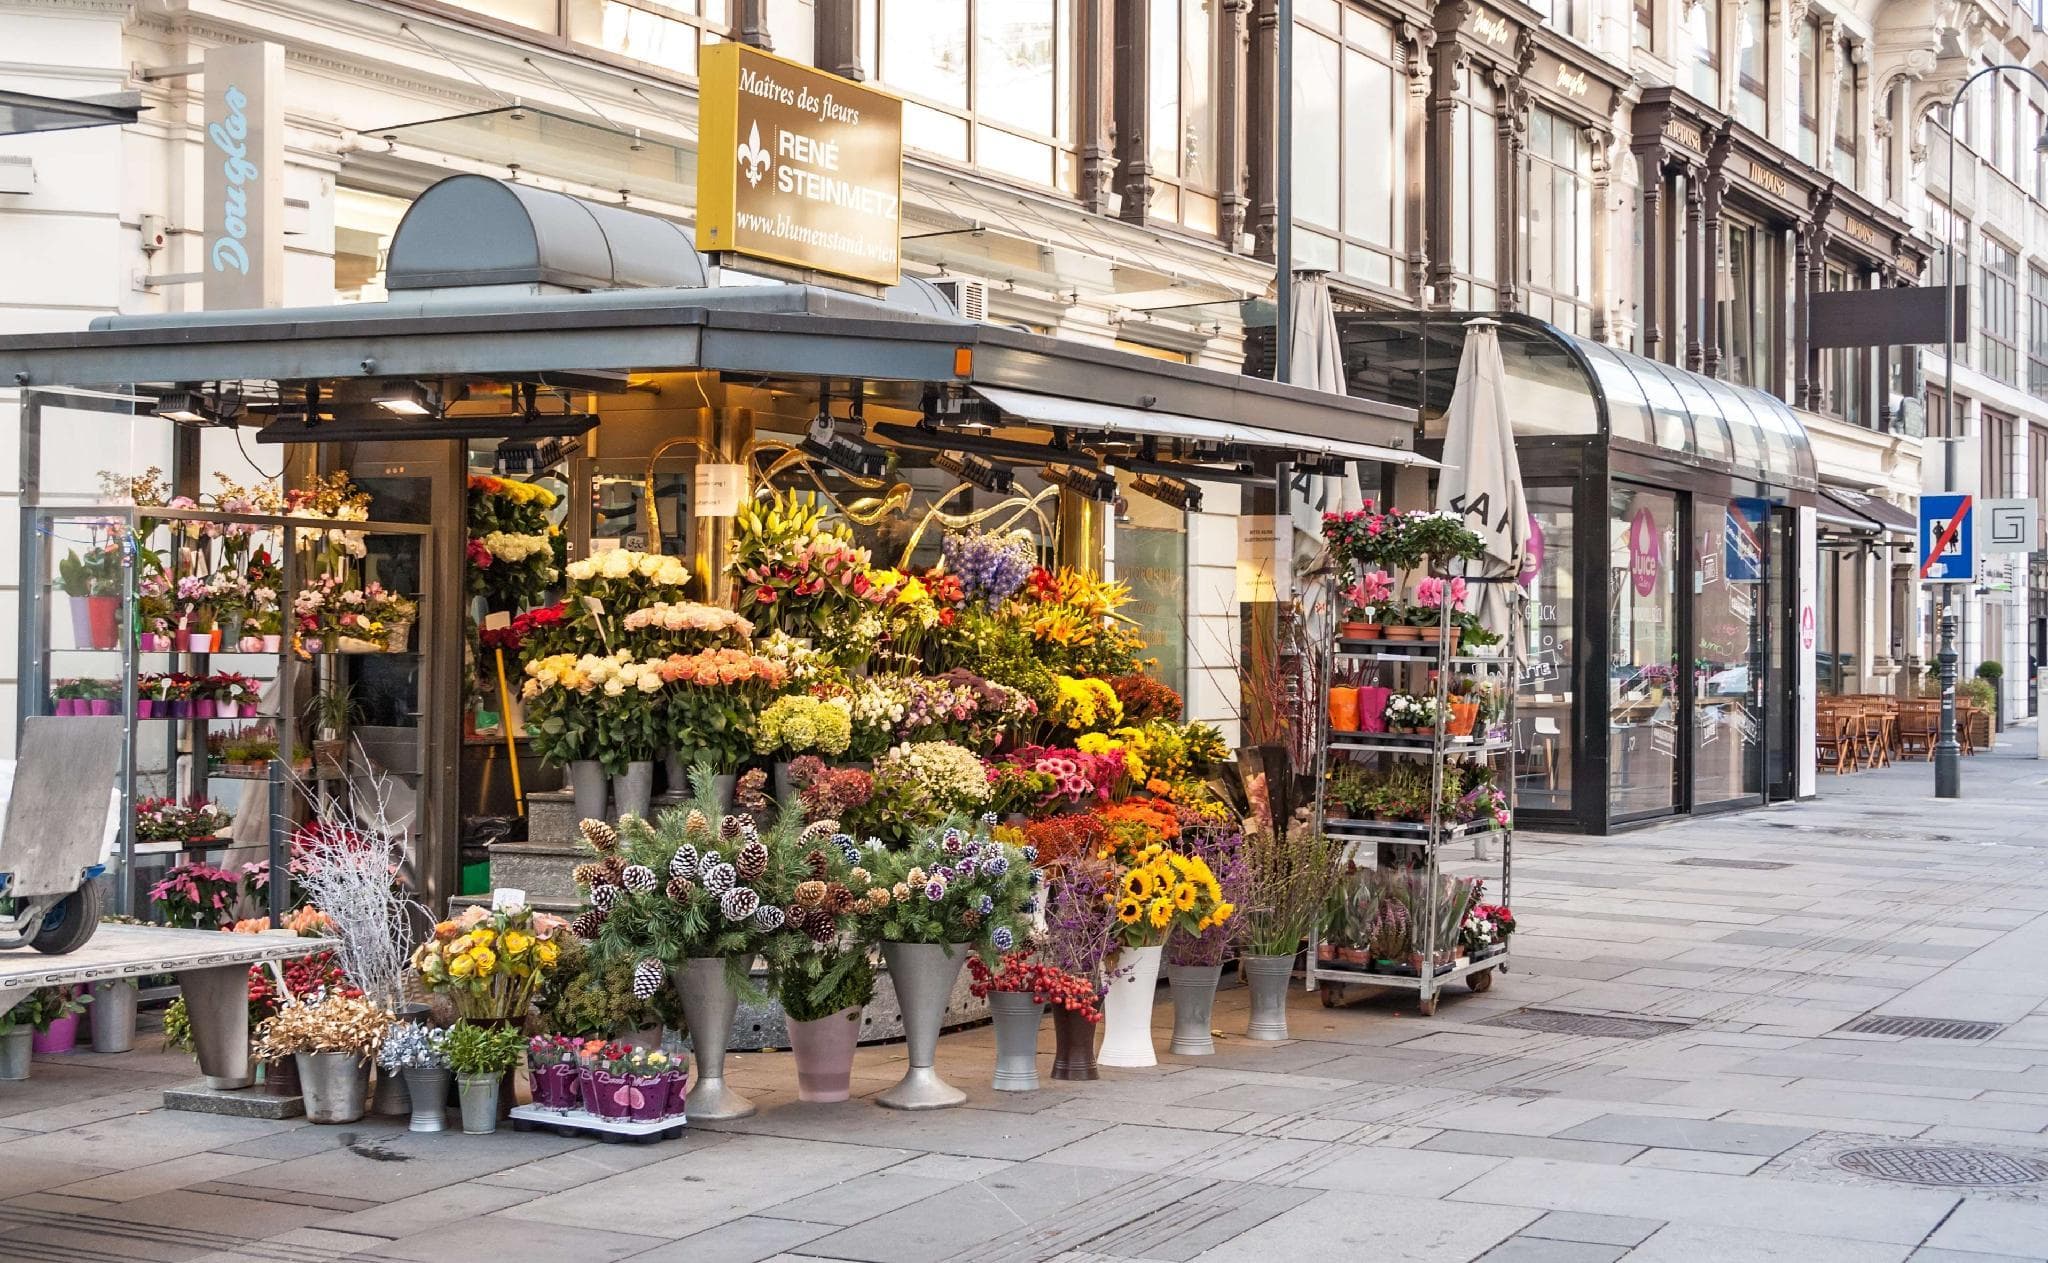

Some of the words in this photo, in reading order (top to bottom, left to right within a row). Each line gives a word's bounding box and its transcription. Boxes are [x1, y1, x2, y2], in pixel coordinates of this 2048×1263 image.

[739, 68, 794, 106] Maîtres
[797, 87, 819, 114] des
[818, 94, 859, 126] fleurs
[779, 129, 839, 171] RENÉ
[208, 85, 258, 275] Douglas
[777, 164, 898, 222] STEINMETZ
[737, 210, 896, 264] www.blumenstand.wien
[1632, 549, 1656, 576] Juice
